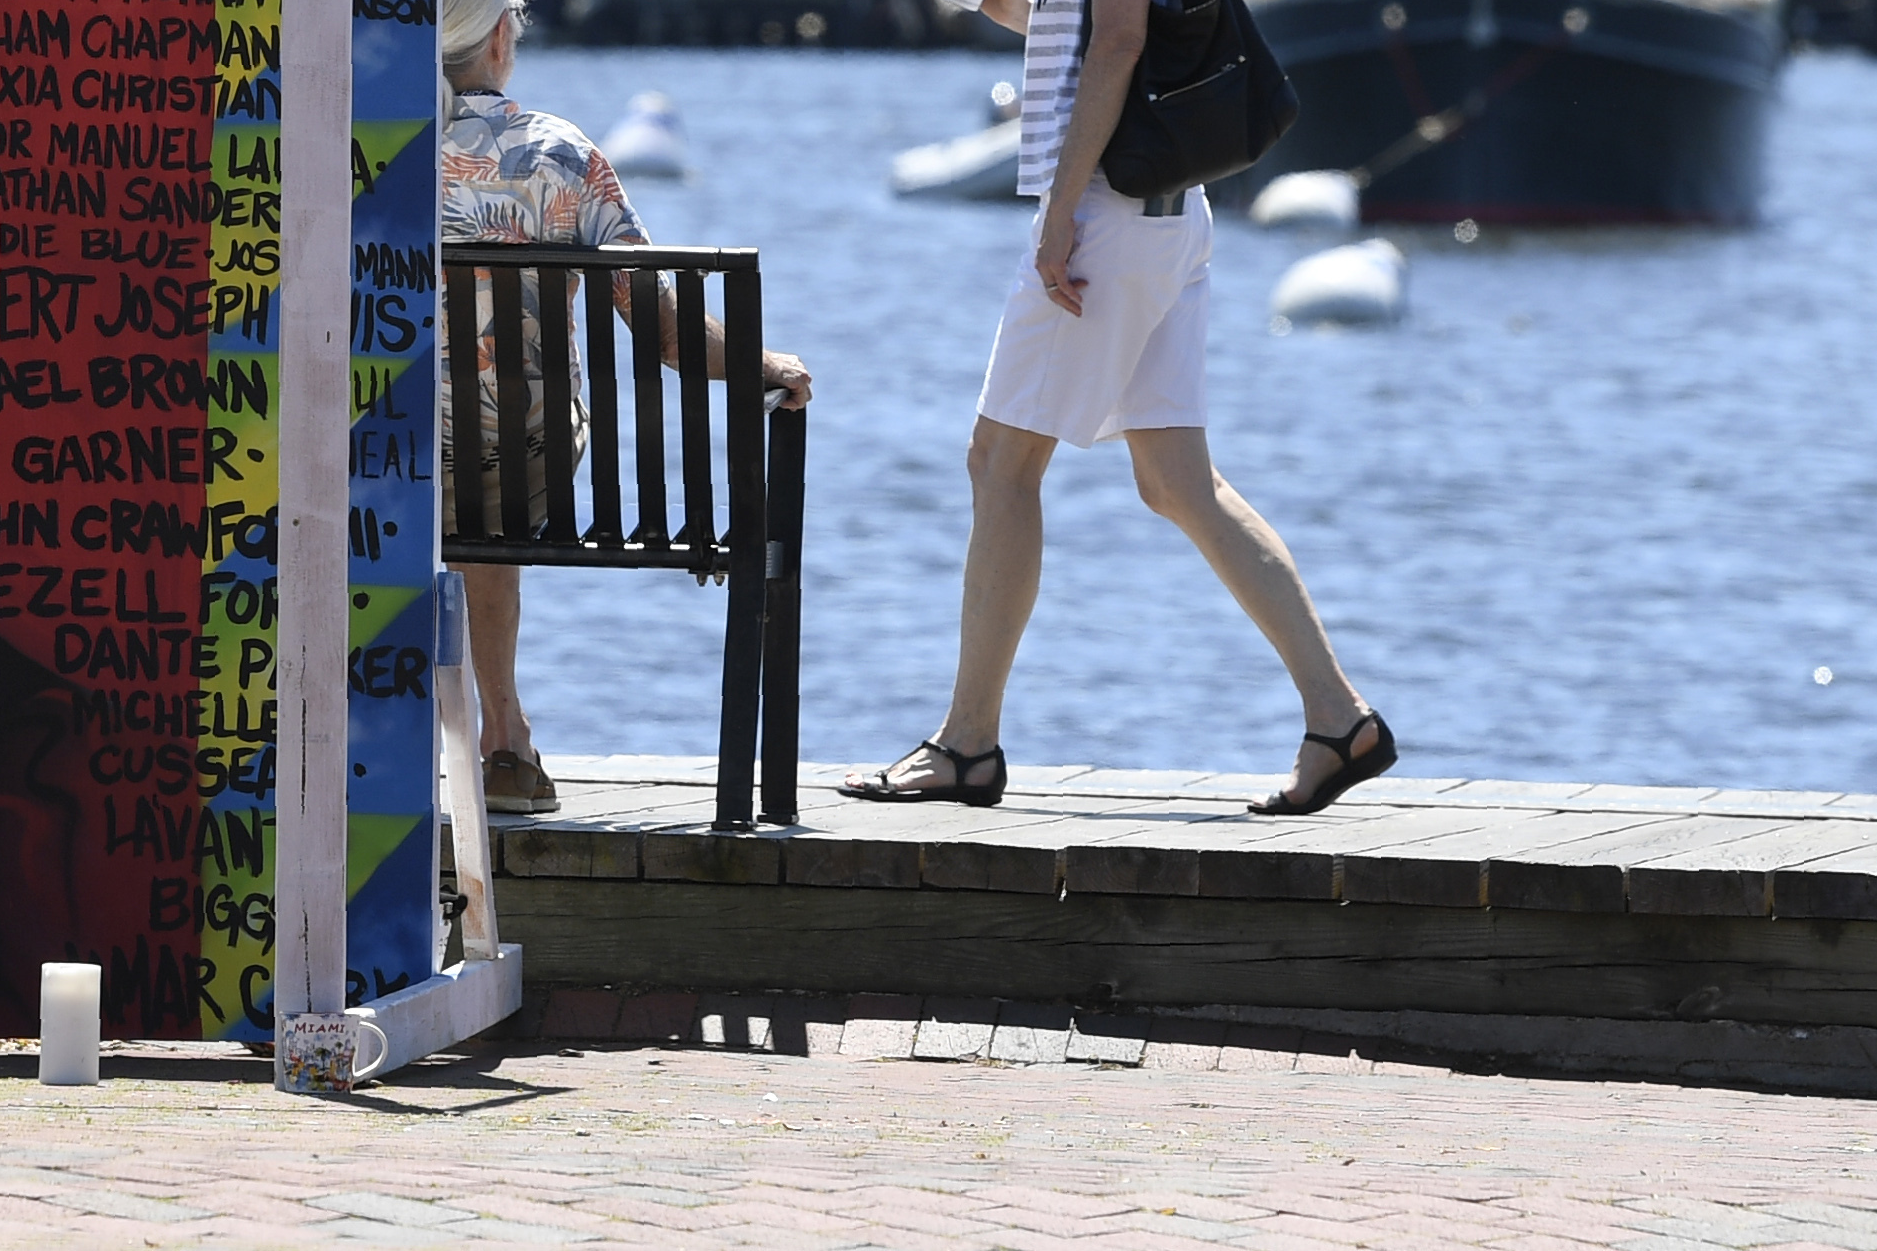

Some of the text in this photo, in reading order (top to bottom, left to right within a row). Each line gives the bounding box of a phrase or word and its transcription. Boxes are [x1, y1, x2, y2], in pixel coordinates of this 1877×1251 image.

[81, 13, 280, 72] CHAPMAN
[71, 63, 281, 120] CHRISTIAN
[47, 122, 213, 172] MANUEL
[119, 176, 281, 233] SANDERS
[81, 229, 200, 269] BLUE
[355, 241, 435, 293] MANN
[94, 273, 269, 346] JOSEPH
[88, 353, 269, 419] BROWN
[11, 427, 244, 484] GARNER
[55, 623, 220, 680] DANTE
[70, 686, 277, 740] MICHELLE
[295, 1022, 345, 1034] MIAMI
